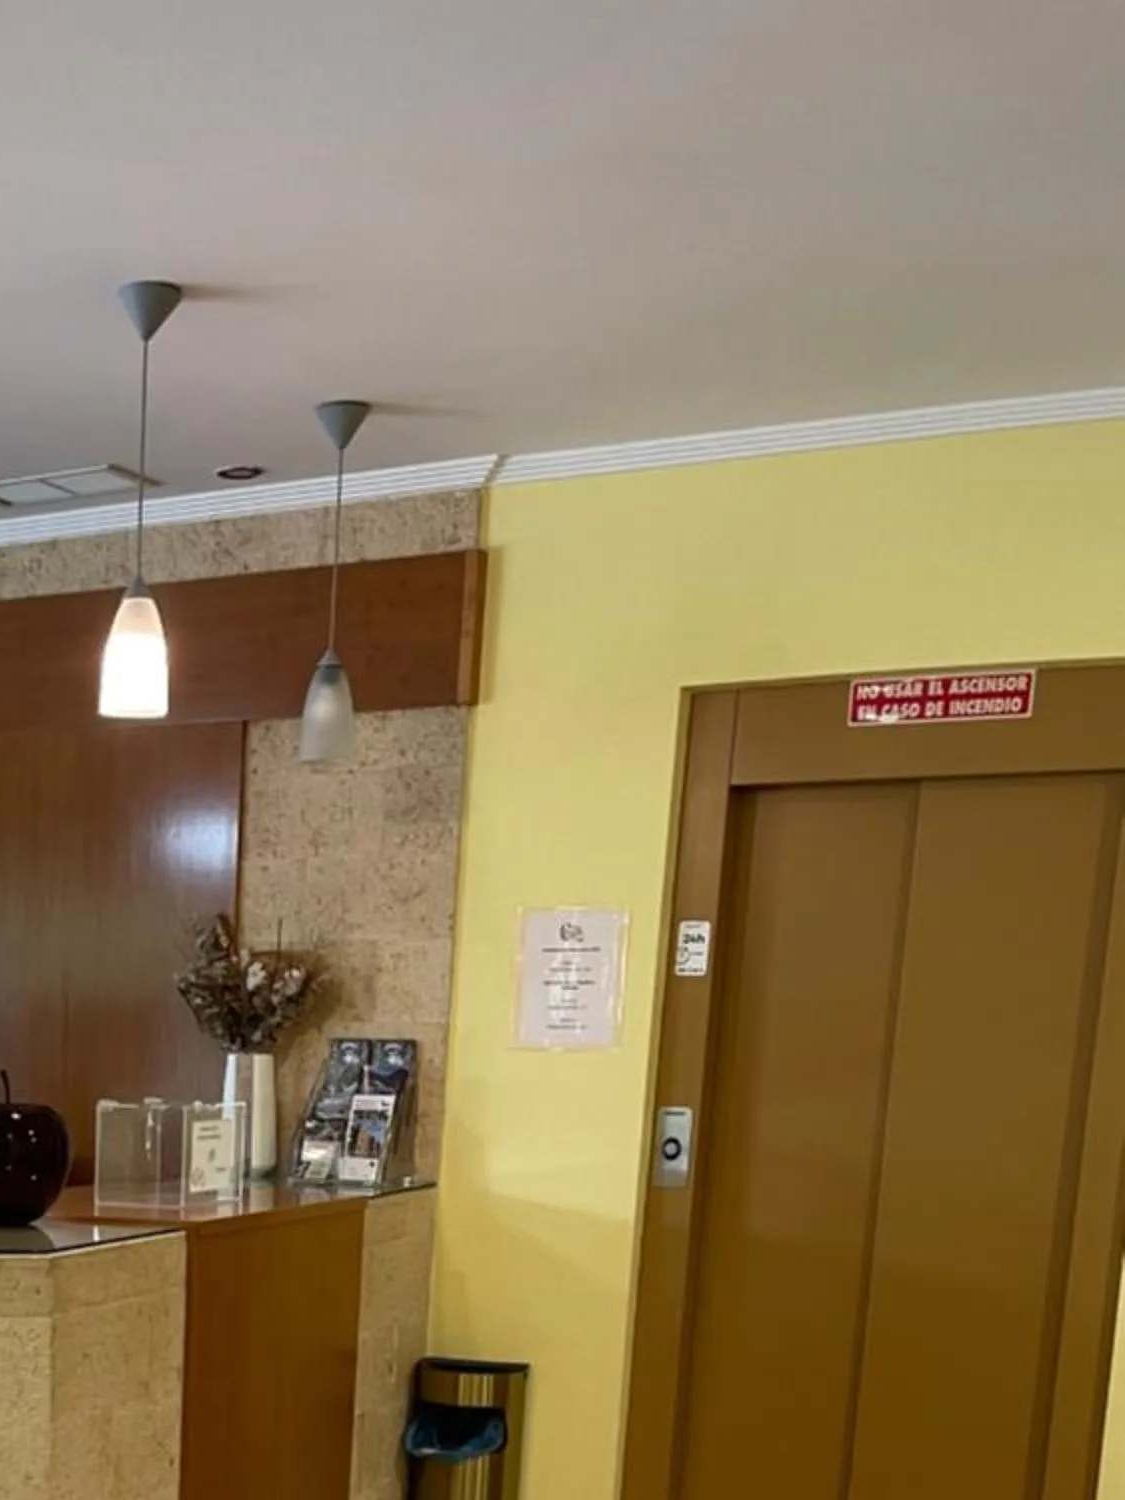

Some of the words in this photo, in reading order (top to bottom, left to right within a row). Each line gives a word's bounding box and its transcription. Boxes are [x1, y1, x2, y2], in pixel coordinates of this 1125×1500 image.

[927, 679, 944, 697] EL
[948, 675, 1028, 695] ASCENSOR
[925, 700, 945, 717] DE
[949, 696, 1023, 716] INCENDIO
